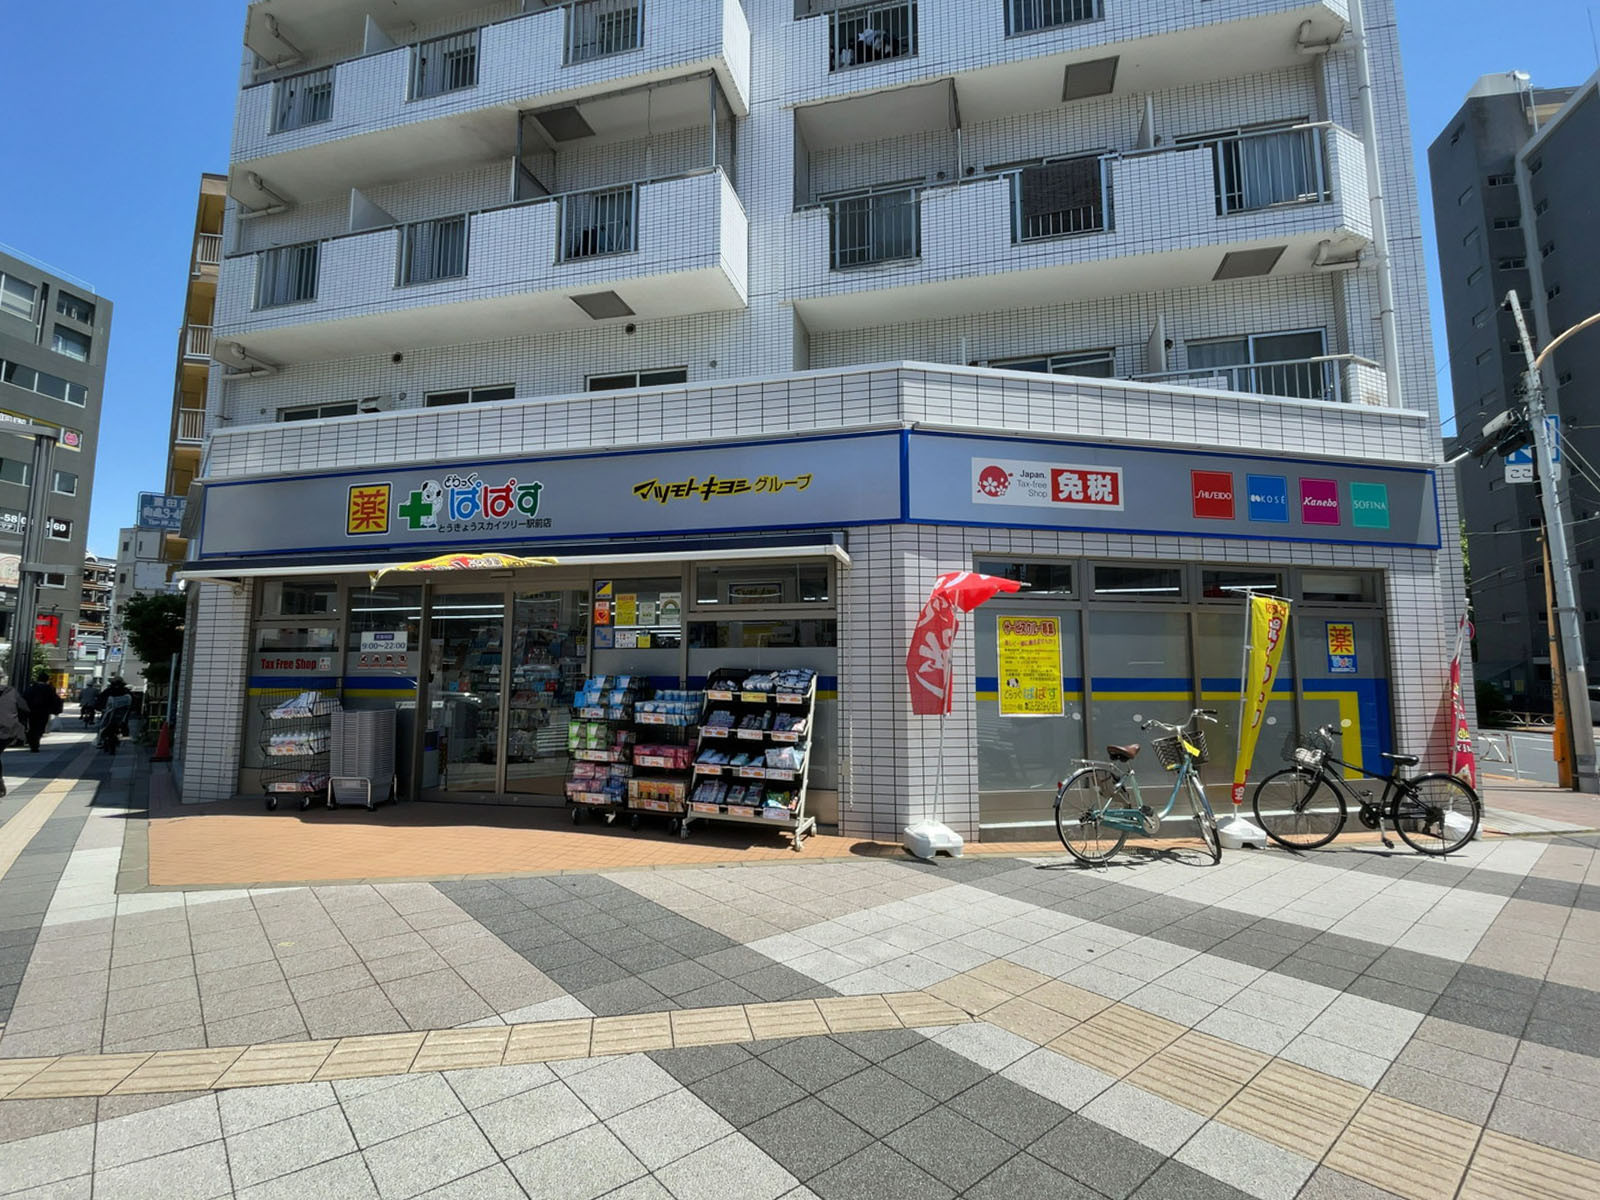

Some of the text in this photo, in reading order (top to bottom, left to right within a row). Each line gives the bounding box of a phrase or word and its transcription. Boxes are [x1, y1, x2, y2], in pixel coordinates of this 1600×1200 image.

[1019, 469, 1047, 479] Japan.
[632, 473, 813, 505] マツモトキヨシグループ
[1017, 479, 1048, 489] Tax-free
[1057, 471, 1113, 502] 免税
[448, 478, 544, 521] ぱぱす
[1028, 488, 1048, 498] Shop
[1195, 490, 1232, 500] SHISEIDO
[1303, 496, 1338, 508] Kanebo
[1353, 499, 1387, 510] SOFINA
[352, 488, 387, 531] 薬
[438, 518, 552, 533] とうきょうスカイツリー駅前店
[1329, 625, 1352, 653] 薬
[261, 657, 317, 671] Tax Free Shop
